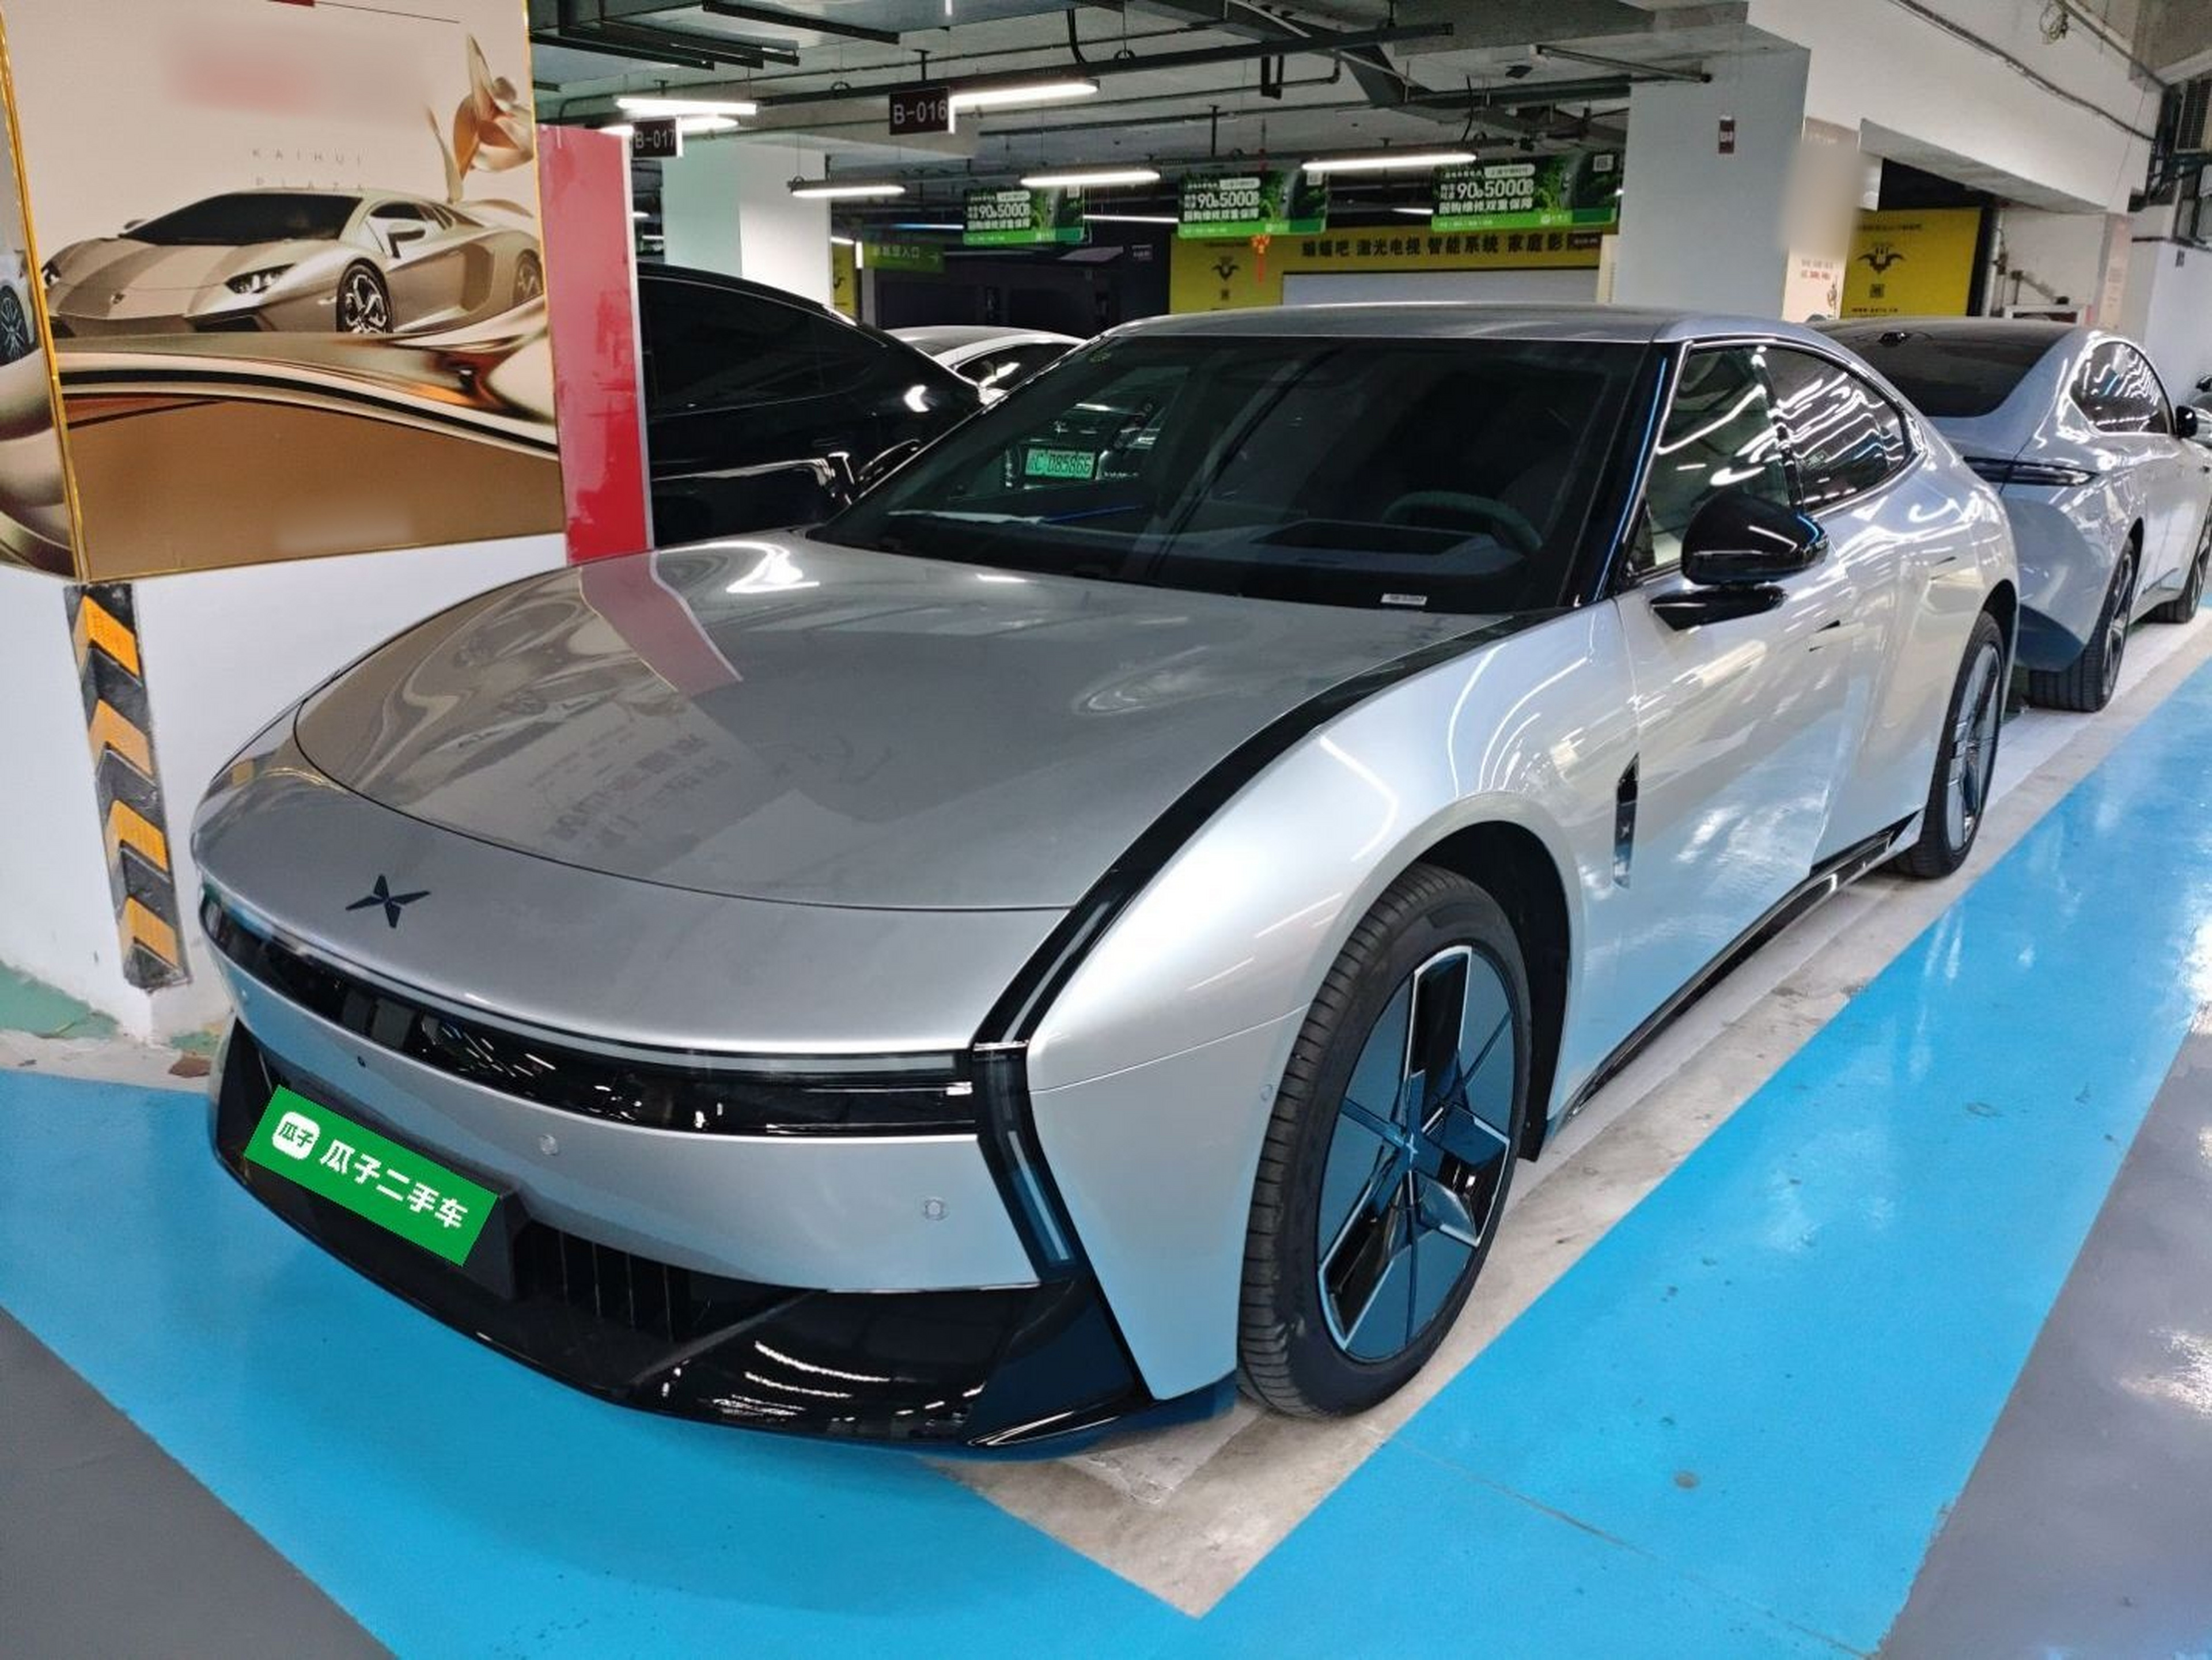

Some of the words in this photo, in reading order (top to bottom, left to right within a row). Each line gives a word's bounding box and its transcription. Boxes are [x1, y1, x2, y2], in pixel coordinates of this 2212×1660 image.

[893, 99, 948, 124] B-016
[635, 130, 675, 149] B-017
[1508, 232, 1581, 252] 家庭影
